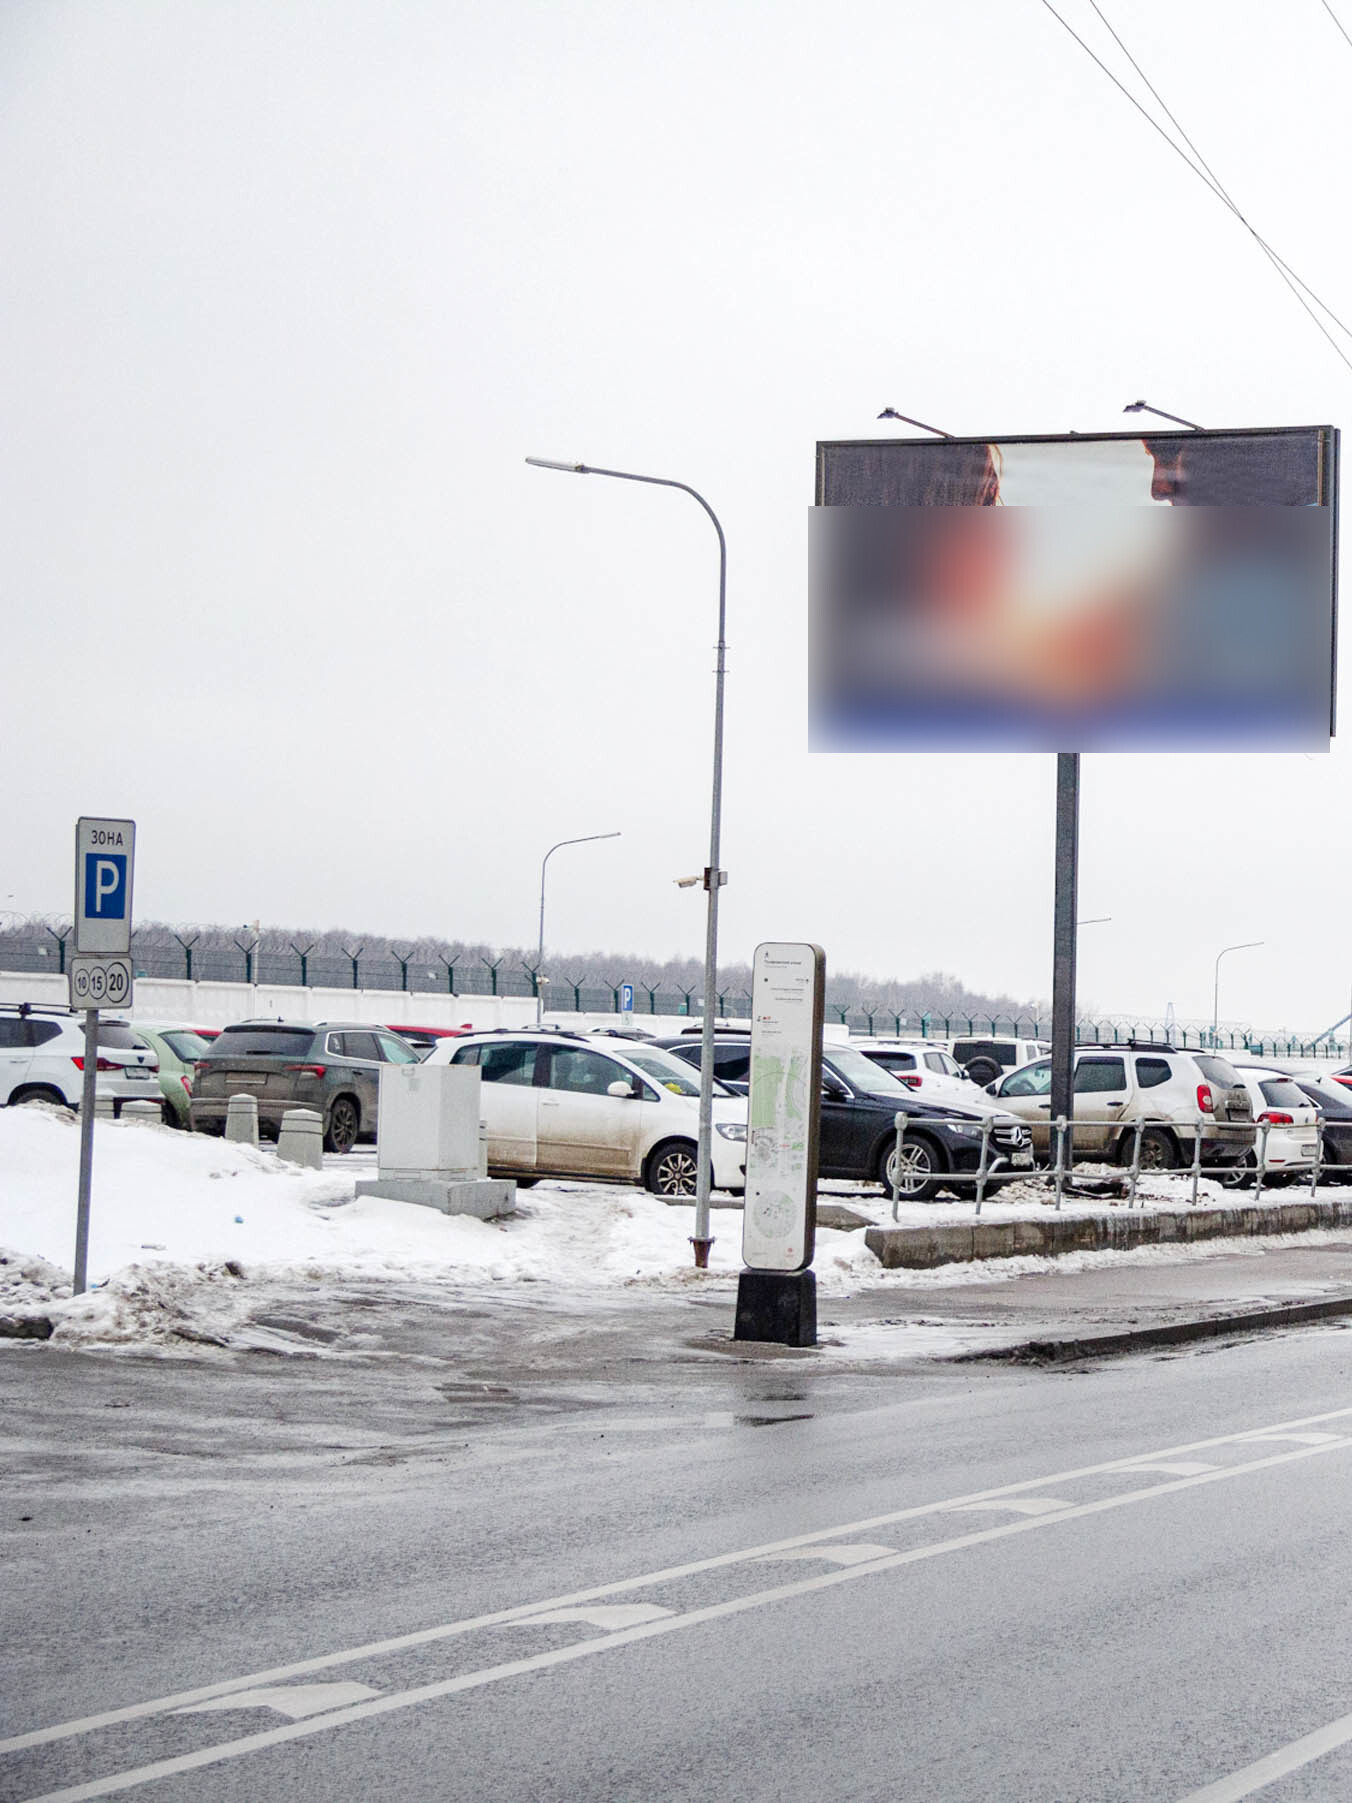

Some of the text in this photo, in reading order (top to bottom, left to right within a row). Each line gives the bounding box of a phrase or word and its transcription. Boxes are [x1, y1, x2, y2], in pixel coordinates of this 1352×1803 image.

[91, 830, 124, 846] ЗОНА
[96, 860, 120, 913] P
[78, 973, 124, 991] 10 15 20
[624, 988, 631, 1008] P
